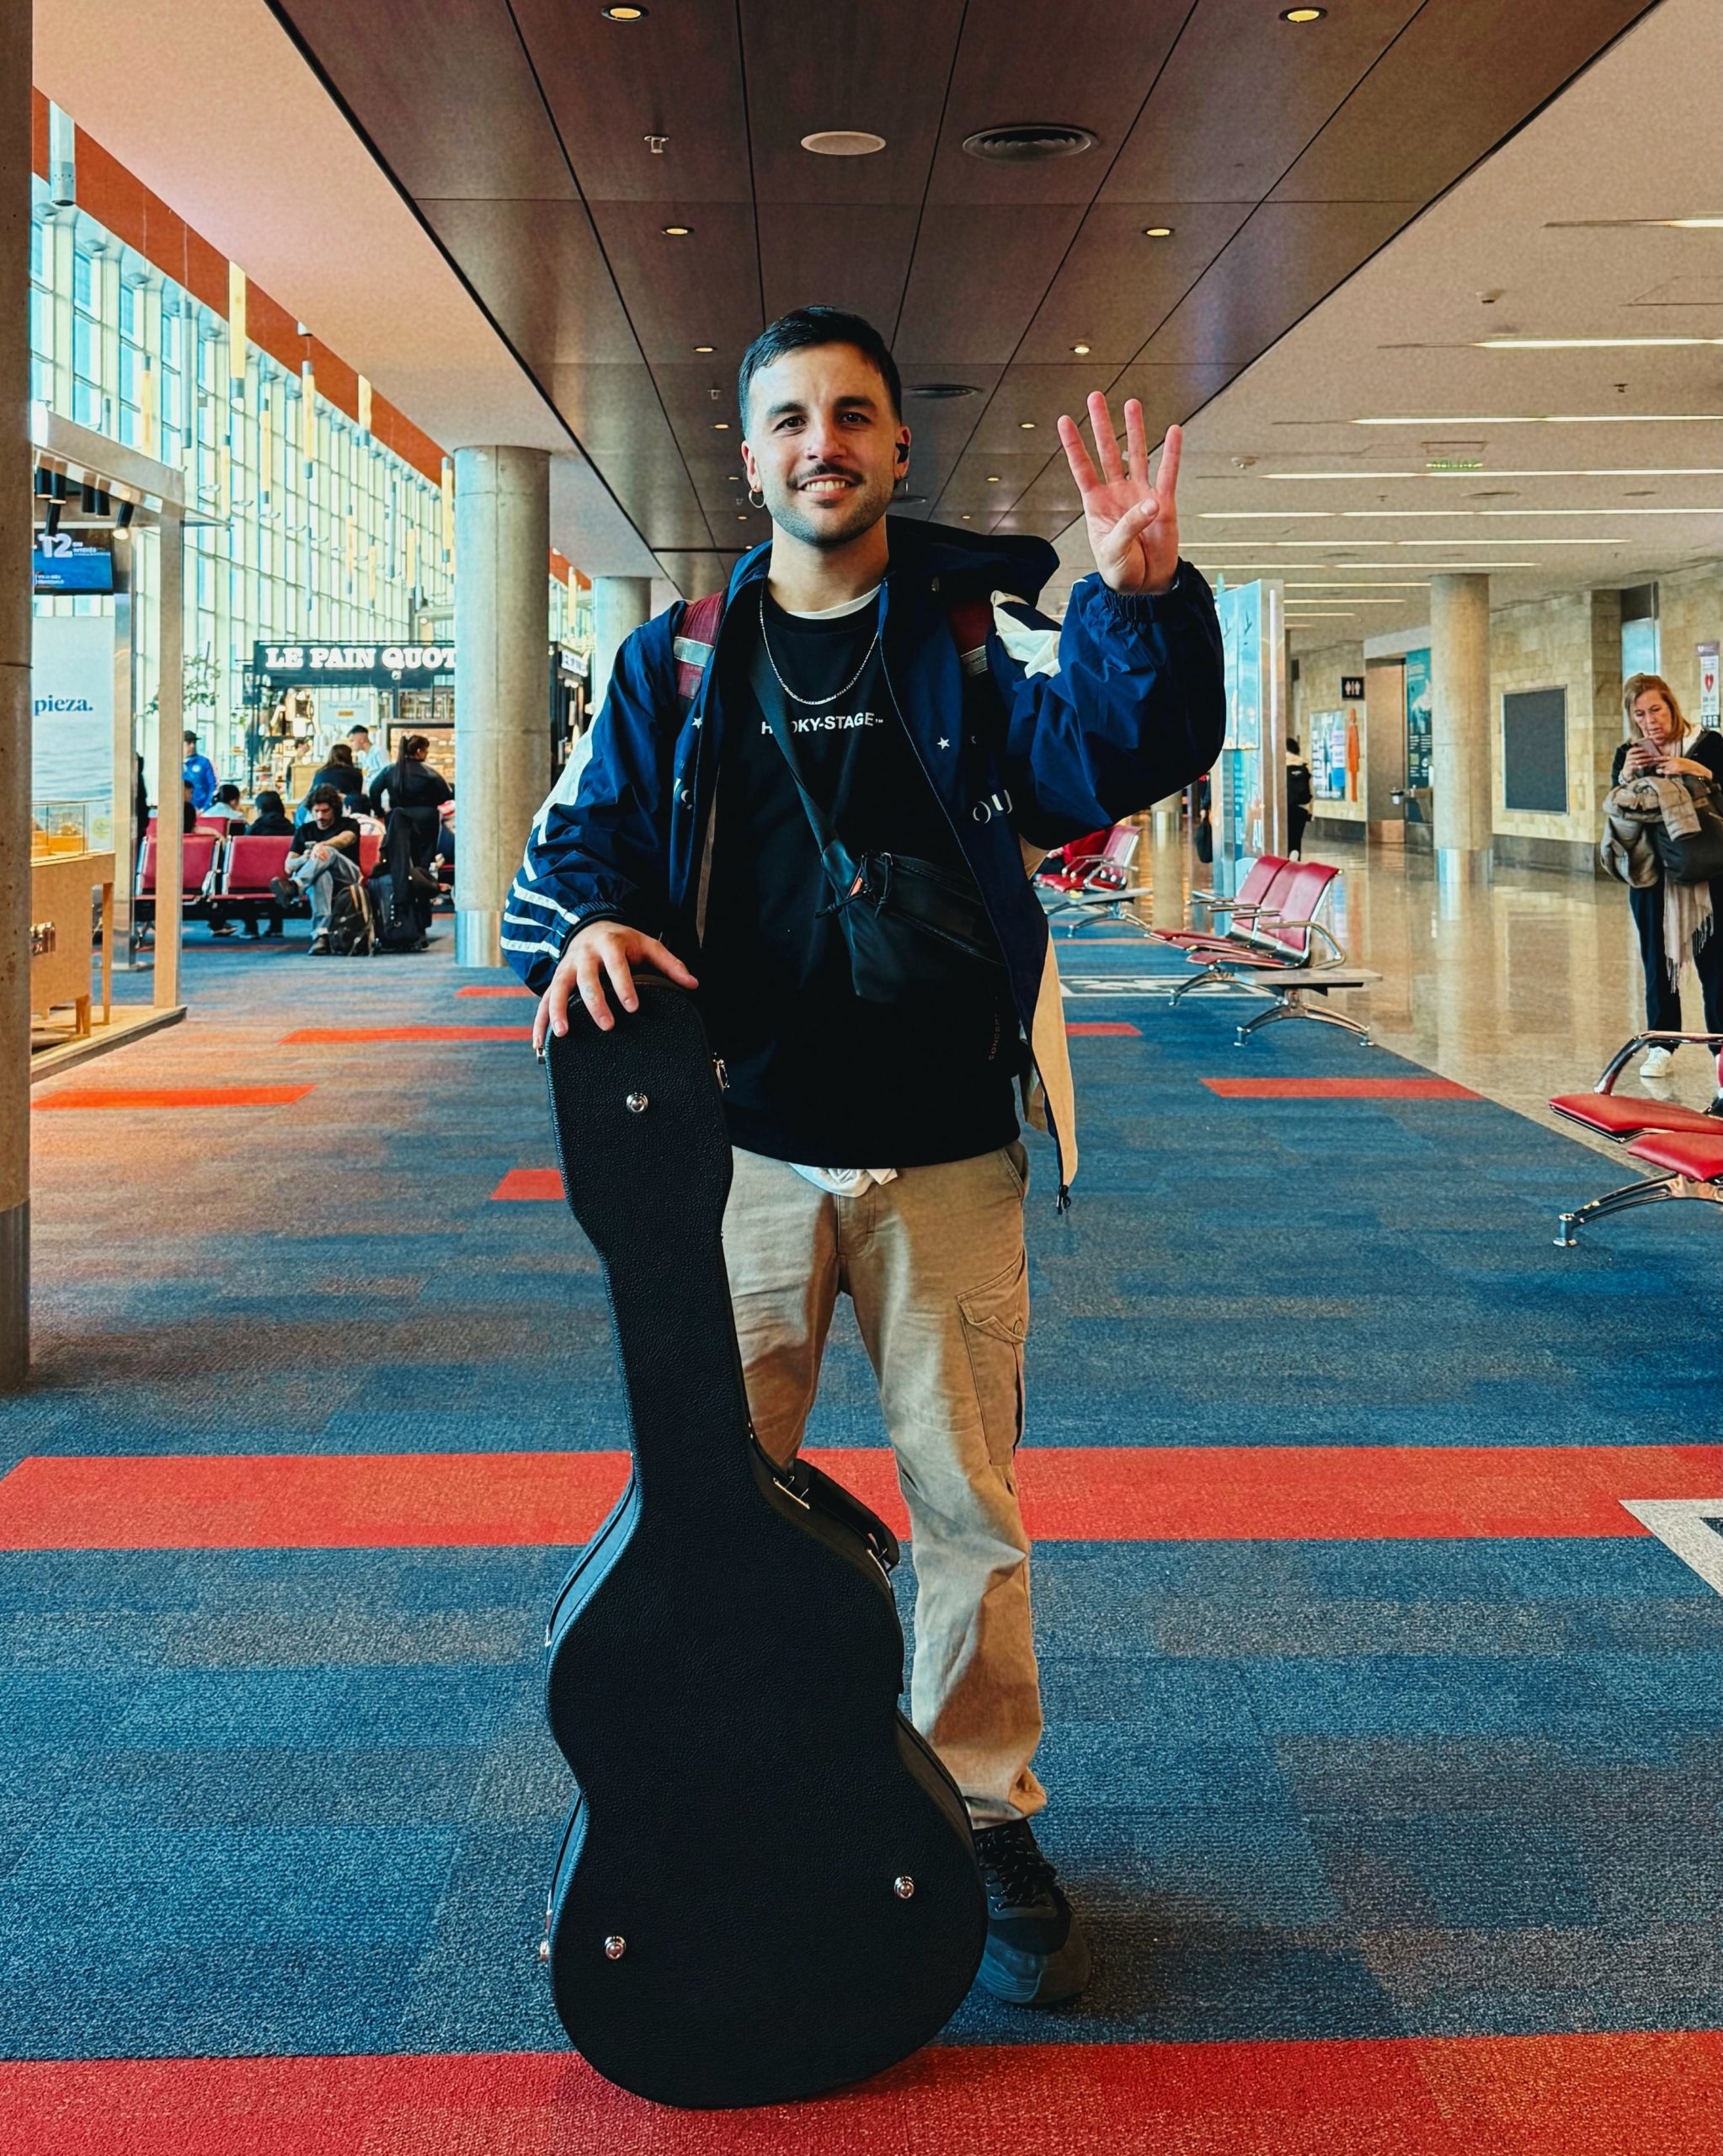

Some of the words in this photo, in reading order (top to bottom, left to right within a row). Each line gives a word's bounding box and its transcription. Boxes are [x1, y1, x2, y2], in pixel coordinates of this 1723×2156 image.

[38, 532, 73, 558] 12
[265, 648, 304, 668] LE
[310, 648, 376, 669] PAIN
[381, 647, 456, 670] QUOT
[35, 694, 93, 717] pieza.
